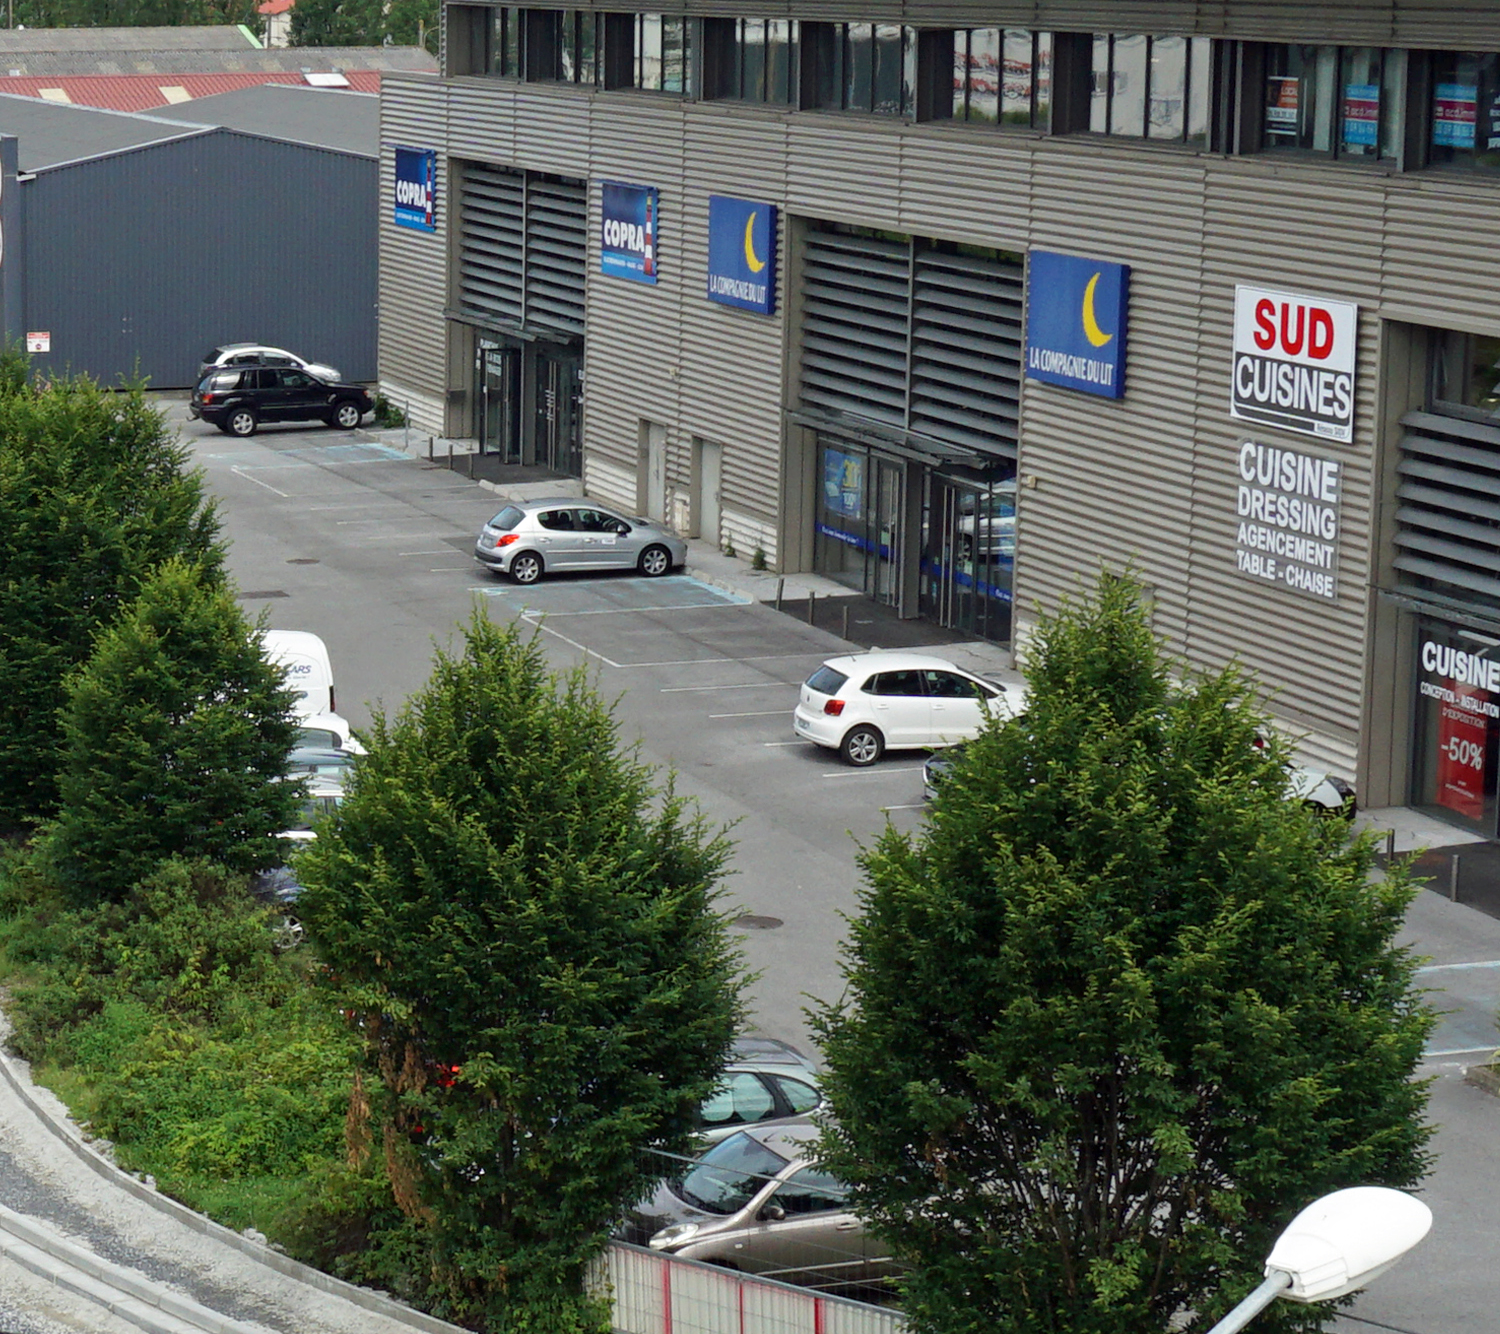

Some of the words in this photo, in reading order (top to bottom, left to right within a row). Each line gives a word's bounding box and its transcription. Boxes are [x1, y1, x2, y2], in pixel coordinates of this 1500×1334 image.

[397, 180, 426, 208] COPRA
[604, 219, 644, 253] COPRA
[709, 274, 716, 293] LA
[717, 276, 748, 301] COMPAGNIE
[748, 283, 756, 302] DU
[757, 285, 766, 304] LIT
[1253, 298, 1334, 360] SUD
[1029, 346, 1040, 369] LA
[1041, 349, 1087, 380] COMPAGNIE
[1087, 359, 1099, 382] DU
[1100, 362, 1114, 385] LIT
[1236, 355, 1350, 419] CUISINES
[1239, 442, 1339, 503] CUISINE
[1237, 485, 1336, 540] DRESSING
[1237, 522, 1334, 569] AGENCEMENT
[1236, 550, 1276, 580] TABLE
[1285, 564, 1334, 598] CHAISE
[1422, 641, 1500, 693] CUISINE
[1420, 681, 1455, 704] CONCEPTION
[1461, 694, 1500, 718] INSTALLATION
[1441, 736, 1483, 771] -50%
